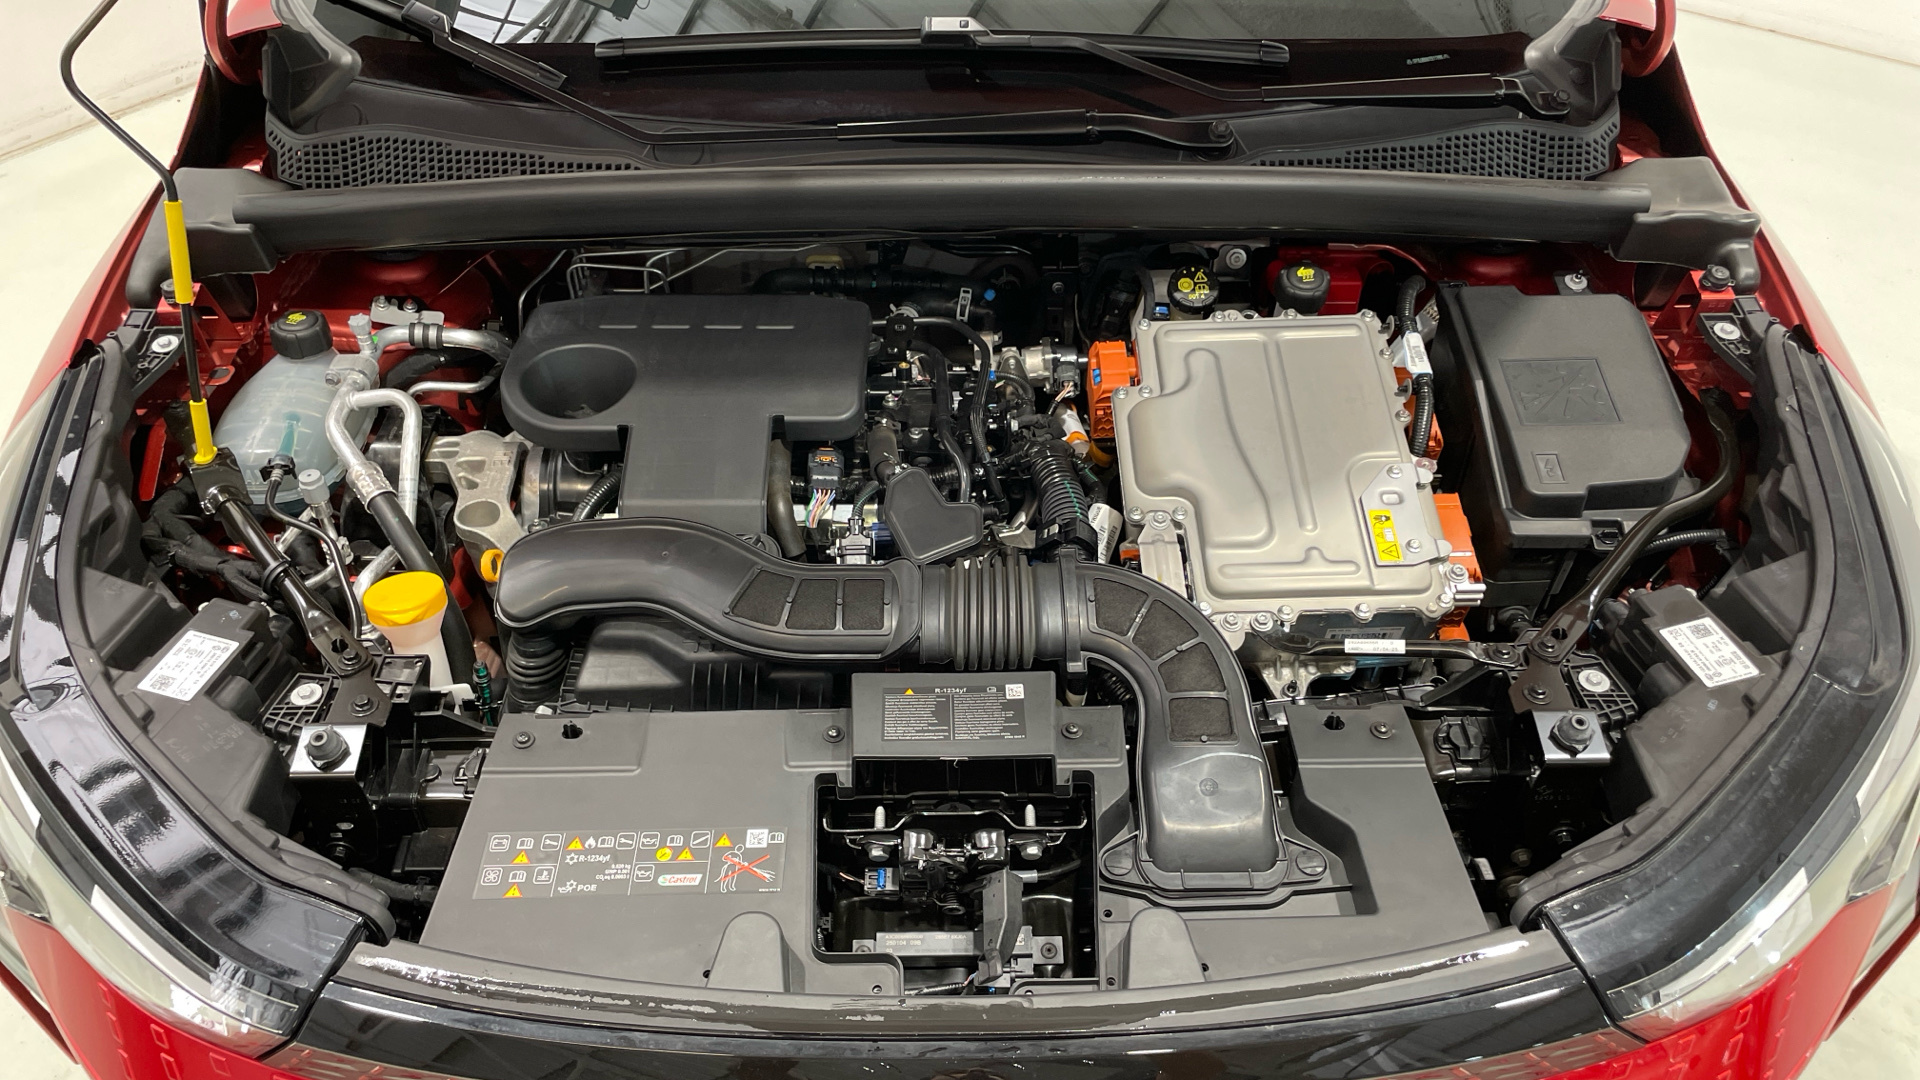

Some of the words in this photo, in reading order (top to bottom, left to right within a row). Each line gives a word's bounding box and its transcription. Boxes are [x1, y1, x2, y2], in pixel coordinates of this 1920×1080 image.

[578, 854, 611, 863] R-1234yf
[668, 876, 697, 884] Castrol
[577, 884, 597, 892] POE
